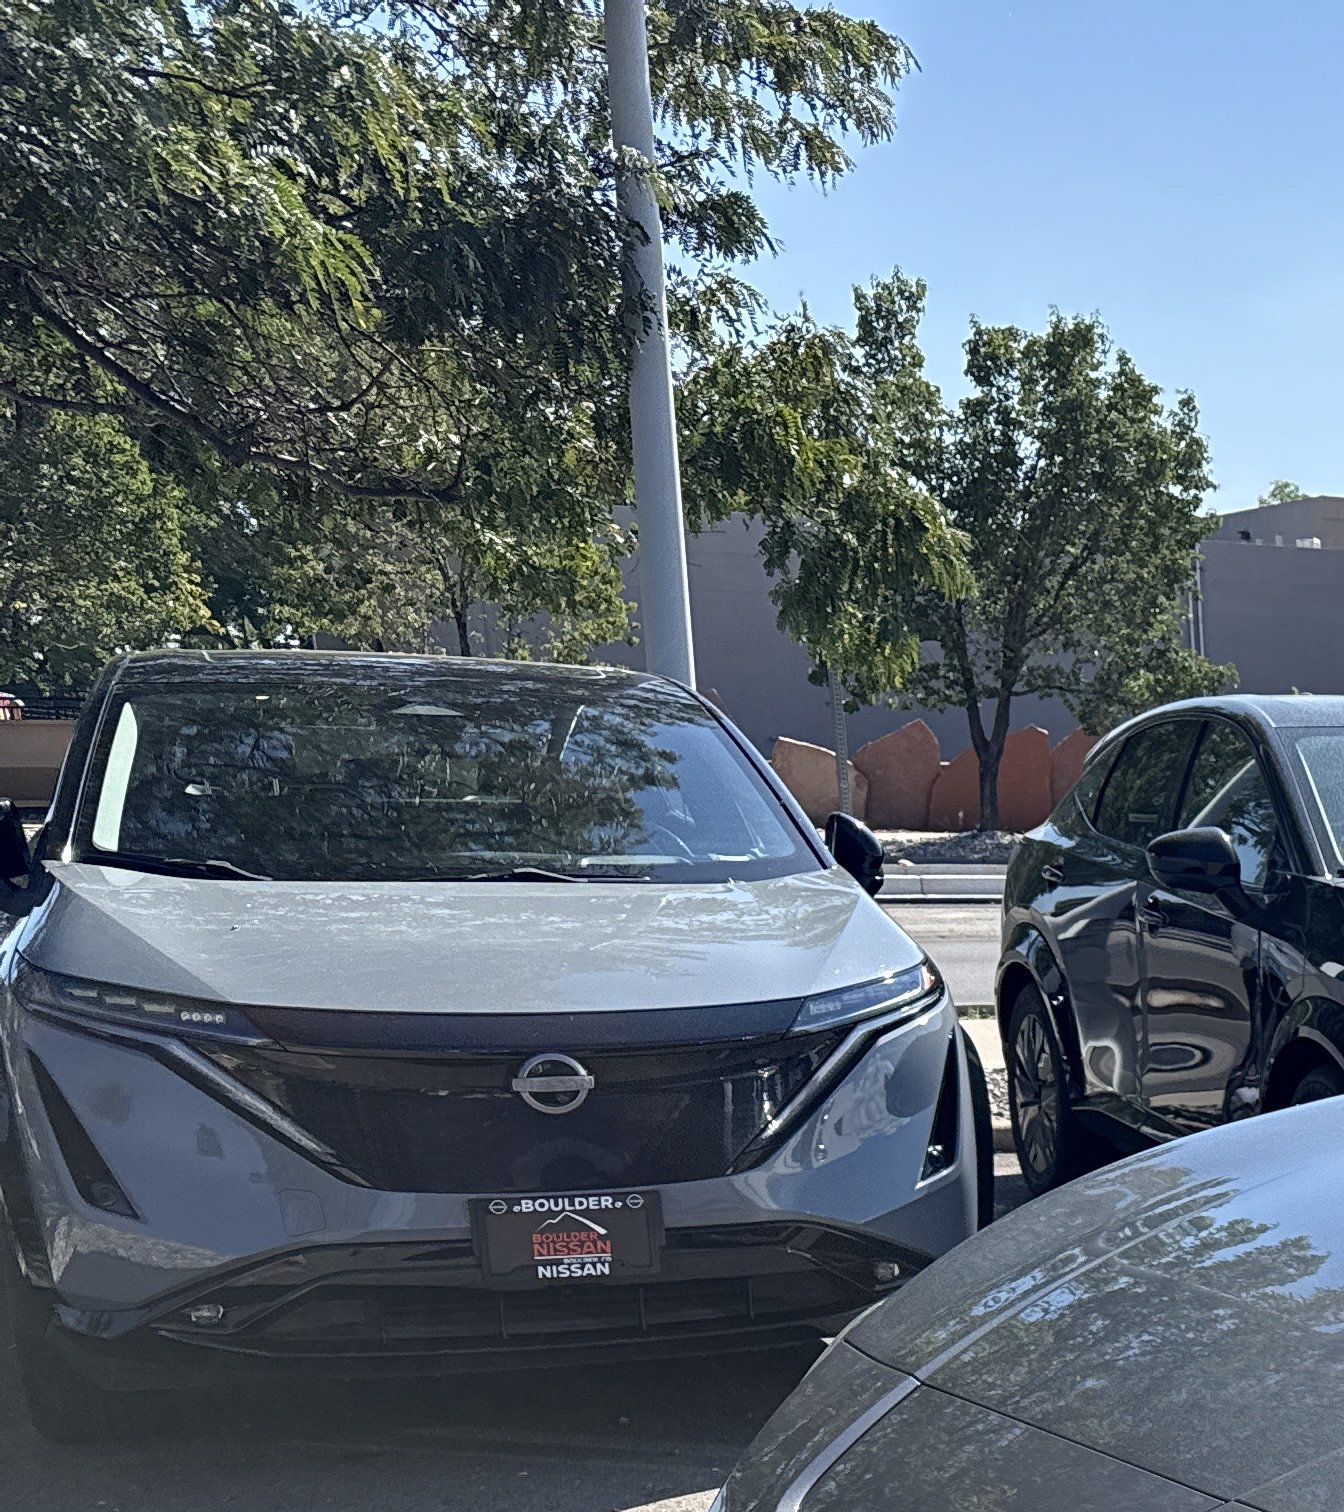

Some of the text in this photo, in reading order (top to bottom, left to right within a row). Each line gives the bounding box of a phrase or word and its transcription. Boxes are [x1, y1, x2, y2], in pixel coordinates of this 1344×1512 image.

[521, 1197, 613, 1212] BOULDER
[532, 1232, 599, 1243] BOULDER
[533, 1241, 611, 1256] NISSAN
[537, 1263, 610, 1278] NISSAN
